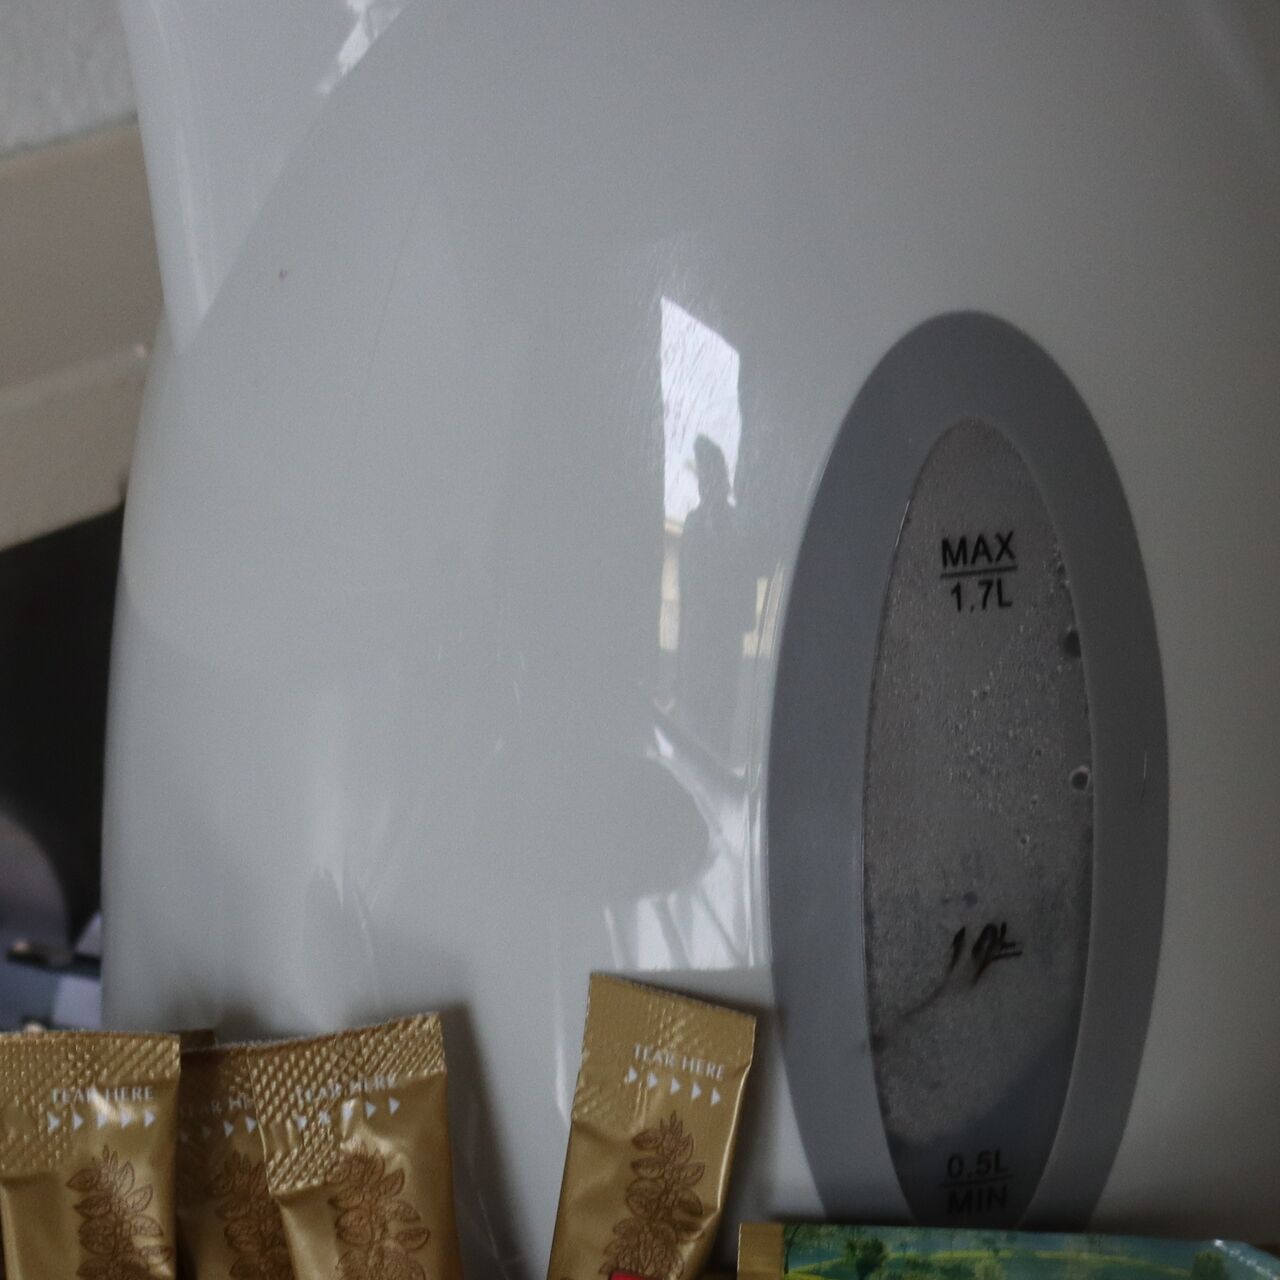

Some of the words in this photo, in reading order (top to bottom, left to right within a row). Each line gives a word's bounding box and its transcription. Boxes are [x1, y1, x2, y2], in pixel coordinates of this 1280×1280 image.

[941, 531, 1016, 567] MAX
[950, 578, 1013, 613] 1.7L
[681, 1056, 725, 1081] HERE
[946, 1149, 1008, 1179] 0.5L
[946, 1184, 1008, 1216] MIN
